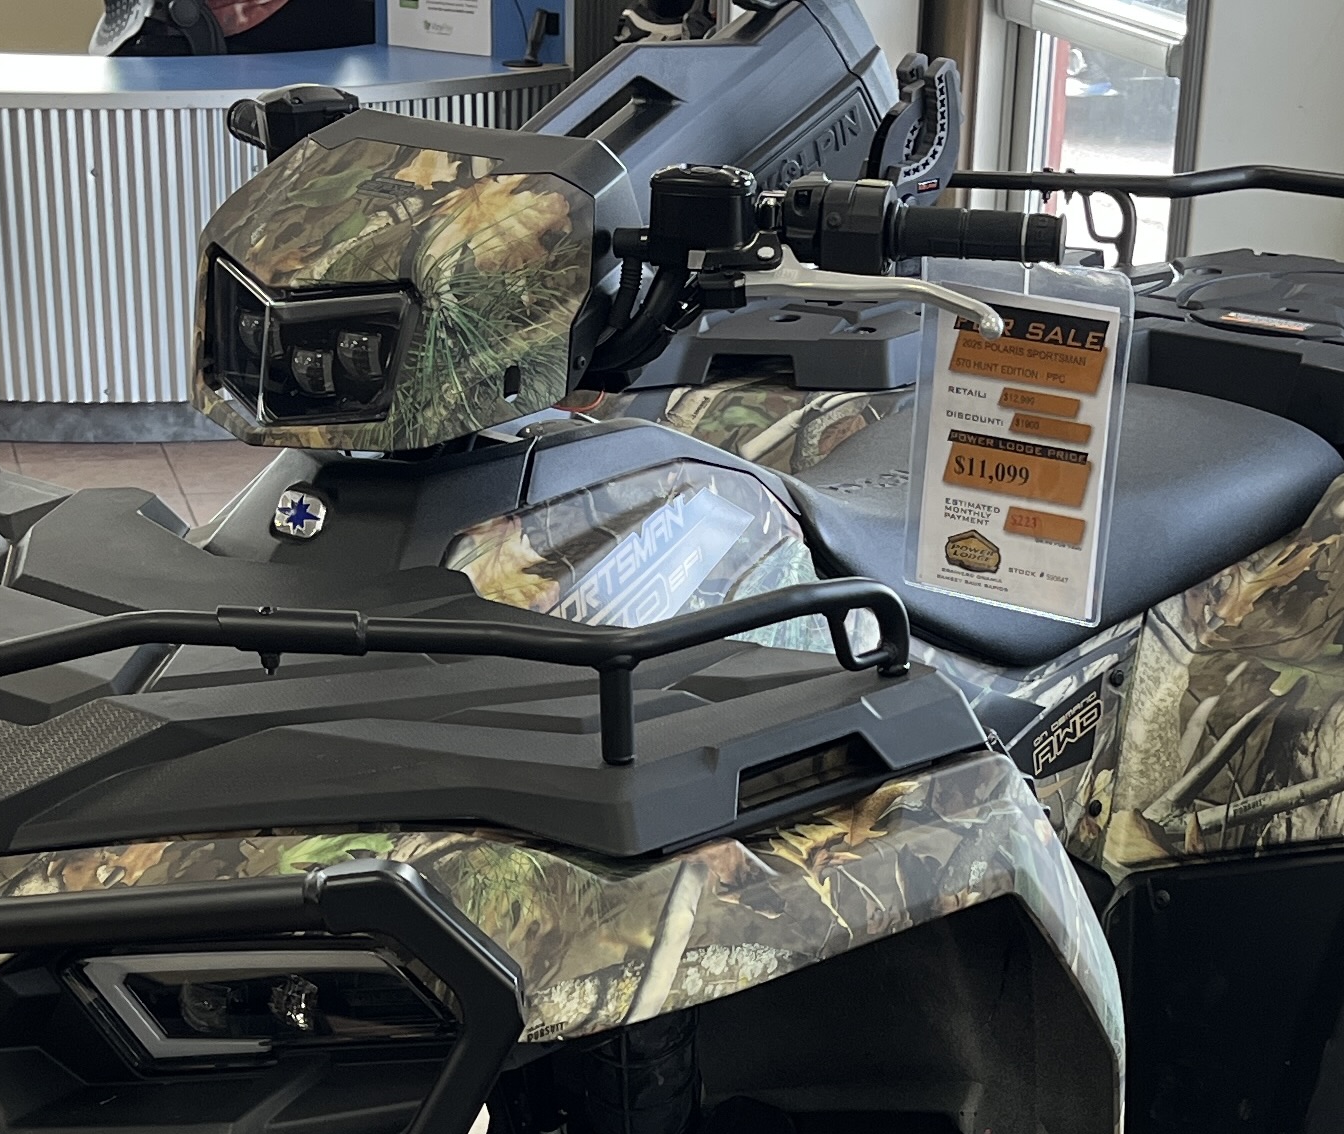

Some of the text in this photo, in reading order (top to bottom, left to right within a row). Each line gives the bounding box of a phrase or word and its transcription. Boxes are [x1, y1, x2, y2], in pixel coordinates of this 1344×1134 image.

[1025, 322, 1105, 351] SALE
[962, 338, 1088, 367] 2025 POLARIS SPORTSMAN
[956, 357, 972, 368] 570
[973, 360, 999, 372] HUNT
[1000, 366, 1039, 380] EDITION
[950, 430, 994, 447] POWER
[998, 441, 1043, 456] LODGE
[953, 454, 1030, 486] $11,099
[944, 505, 992, 519] MONTHLY
[945, 497, 1001, 514] ESTIMATED
[943, 512, 990, 526] PAYMENT
[668, 546, 704, 593] EFI
[1008, 567, 1036, 578] STOCK
[1032, 699, 1103, 777] AWD
